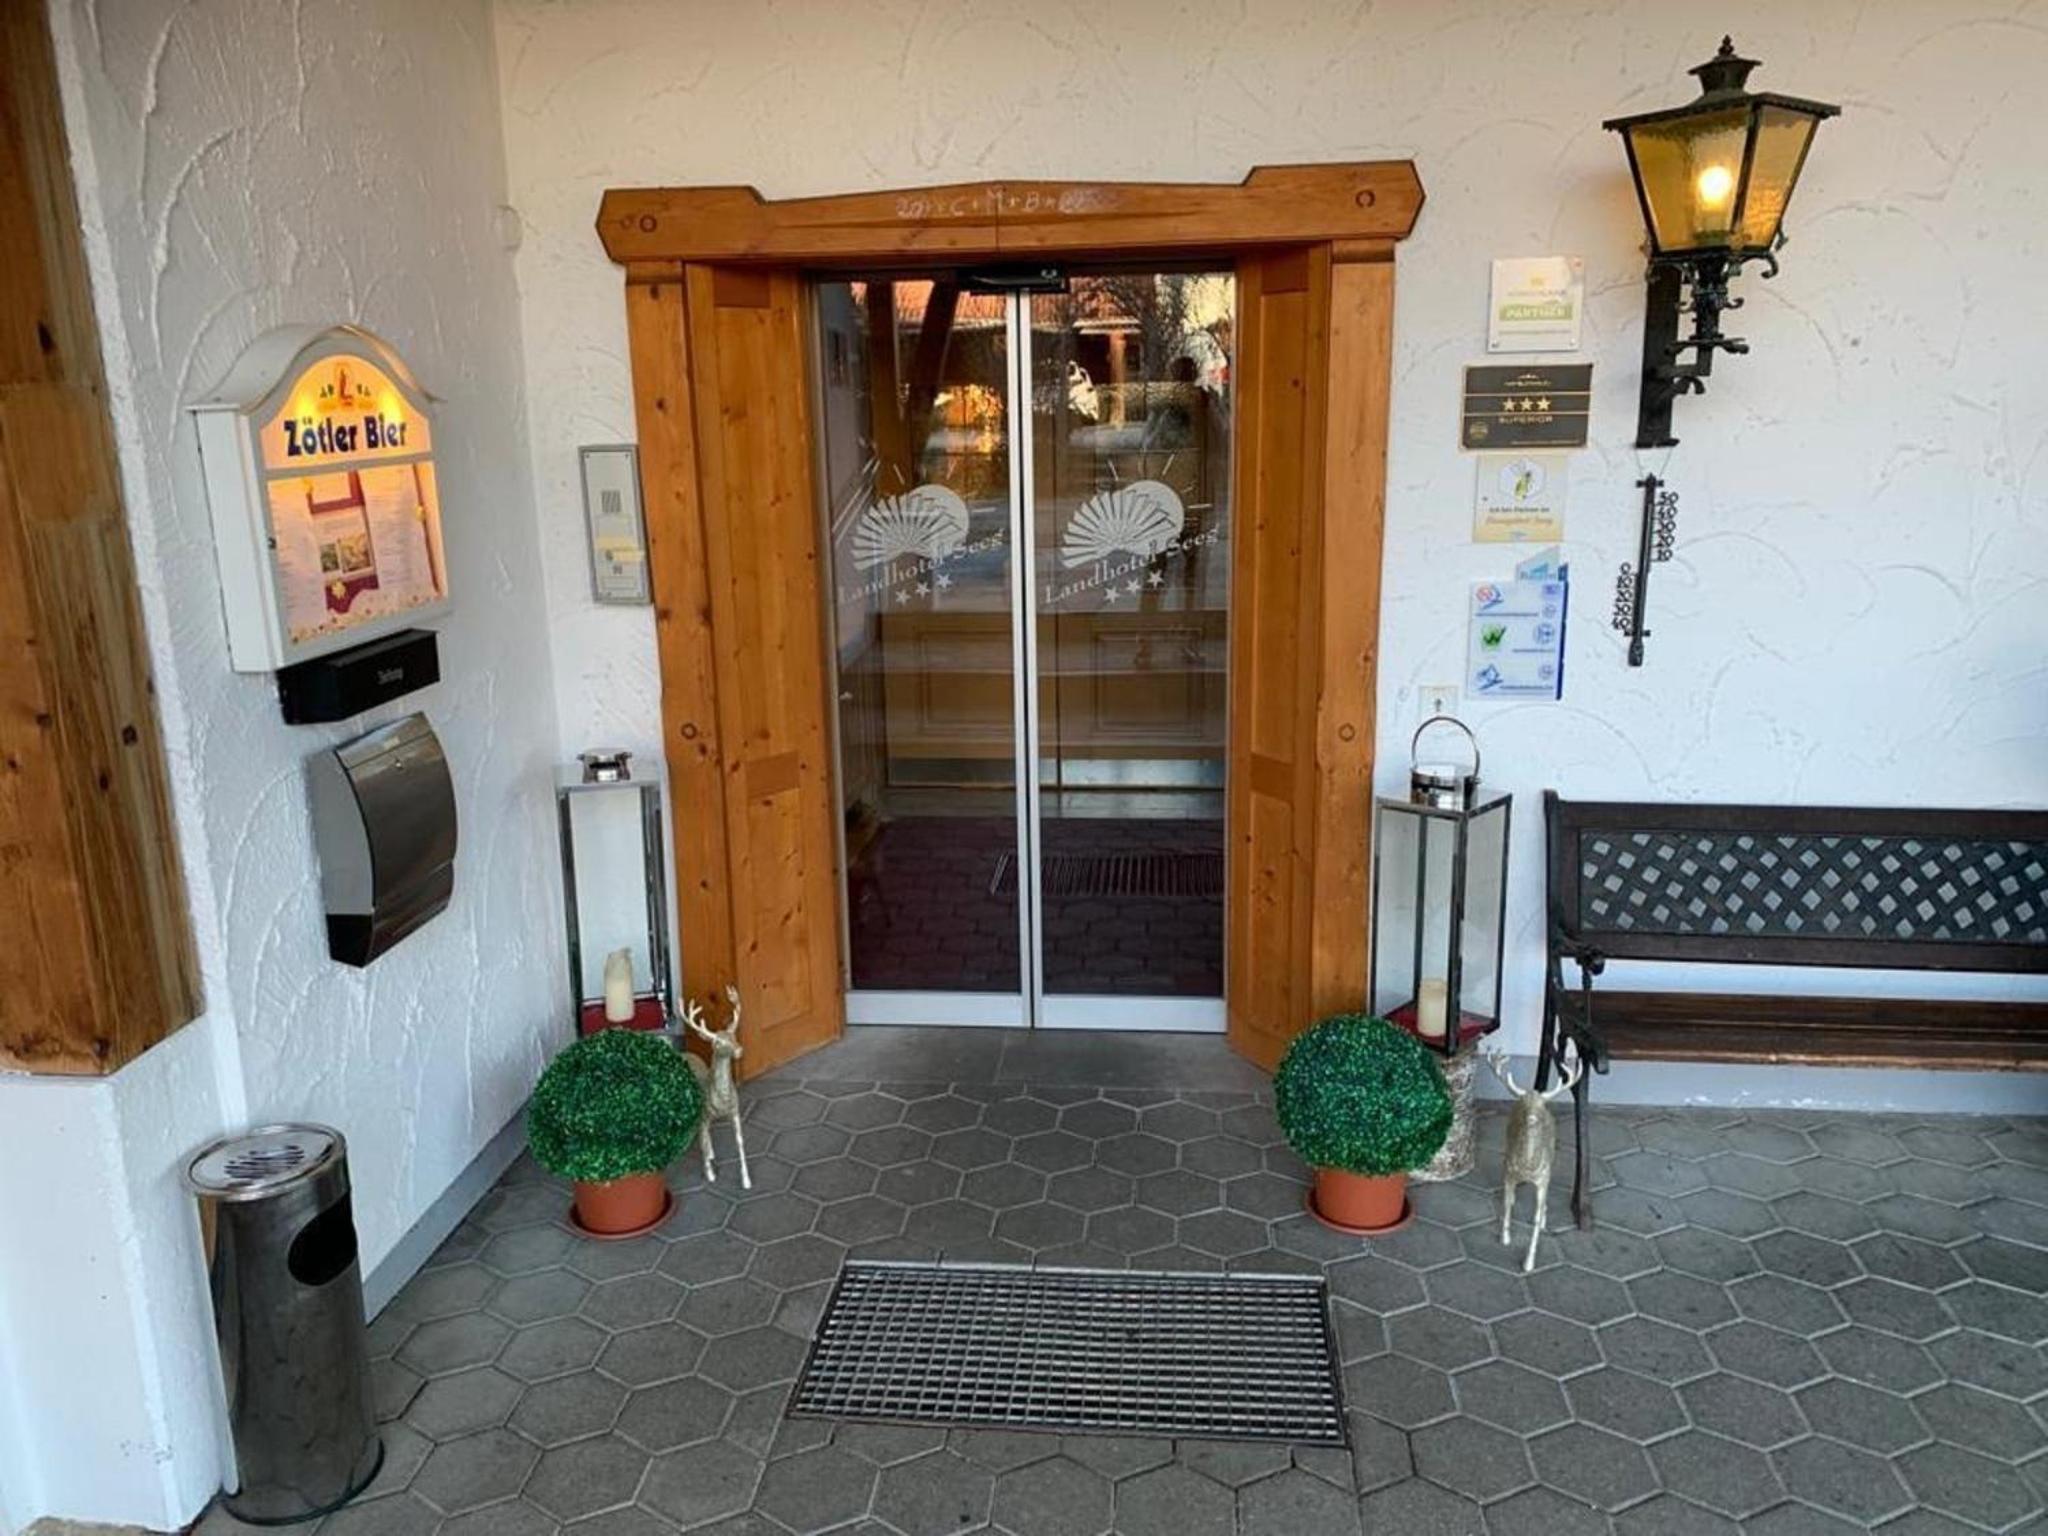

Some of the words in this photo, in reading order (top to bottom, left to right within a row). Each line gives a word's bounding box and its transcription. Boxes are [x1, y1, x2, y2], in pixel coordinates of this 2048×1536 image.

[284, 416, 357, 457] Zötler
[364, 413, 408, 449] Bier
[1045, 538, 1157, 604] Landhotel
